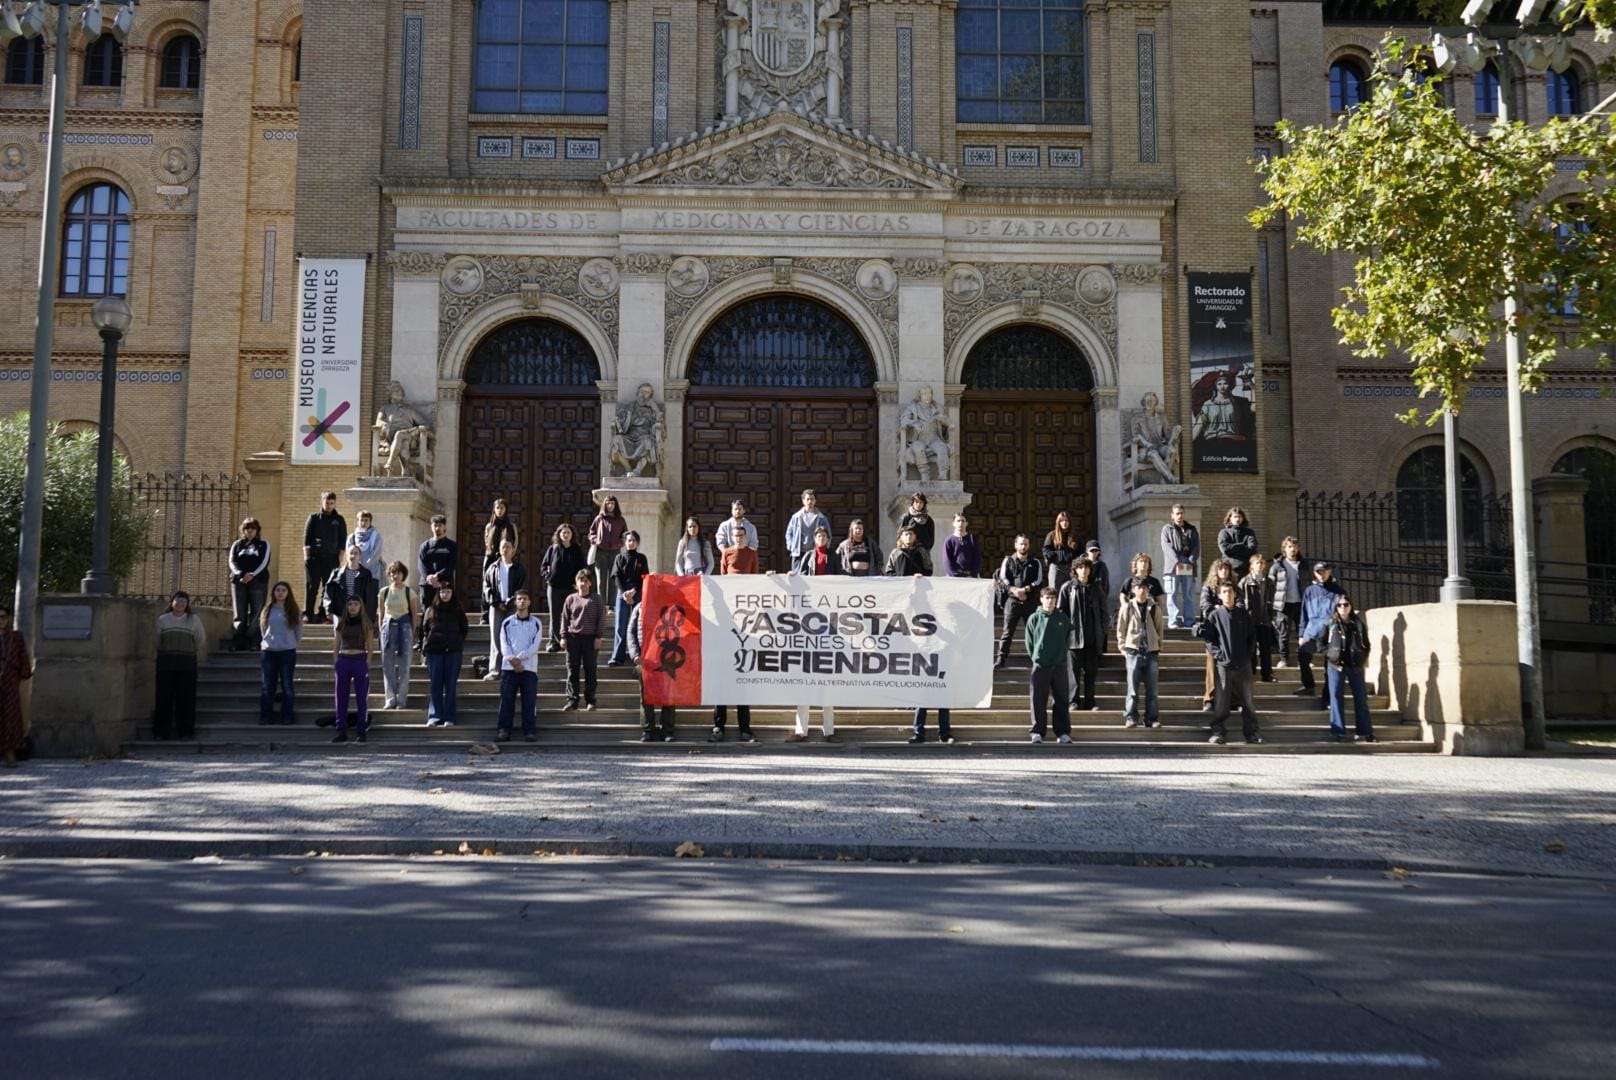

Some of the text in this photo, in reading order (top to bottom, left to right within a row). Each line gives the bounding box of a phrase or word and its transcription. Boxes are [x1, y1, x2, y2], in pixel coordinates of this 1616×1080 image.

[418, 210, 1131, 238] FACULTADES DE MEDICINA Y CIENCIAS DE ZARAGOZA
[1194, 286, 1246, 296] Rectorado
[322, 268, 339, 355] NATURALES
[300, 268, 319, 407] MUSEO DE CIENCIAS
[735, 594, 877, 609] FRENTE A LOS
[732, 608, 938, 636] FASCISTAS
[731, 628, 891, 650] Y QUIENES LOS
[736, 677, 947, 689] CONSTRUYAMOS LA ALTERNATIVA REVOLUCIONARIA
